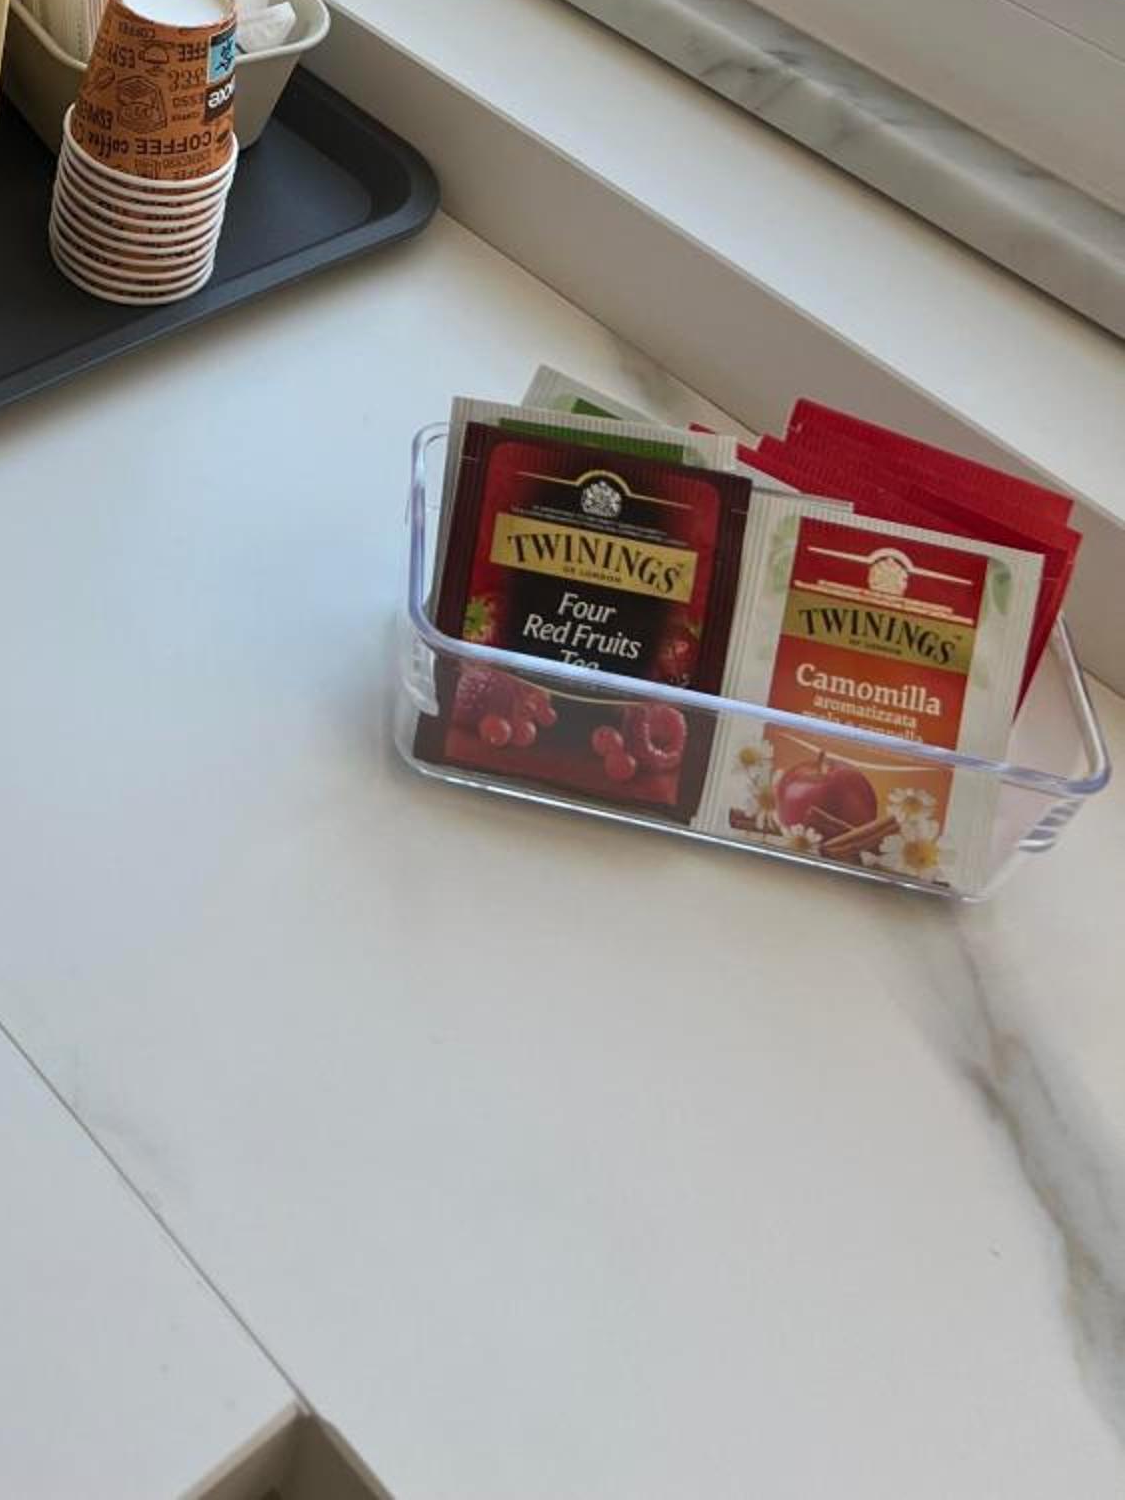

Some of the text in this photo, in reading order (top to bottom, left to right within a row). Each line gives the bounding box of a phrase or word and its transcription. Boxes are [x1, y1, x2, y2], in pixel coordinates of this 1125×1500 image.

[87, 130, 130, 159] coffee
[135, 130, 212, 156] COFFEE
[507, 533, 682, 593] TWININGS
[557, 591, 616, 624] Four
[522, 613, 643, 660] Red Fruits
[799, 607, 956, 665] TWININGS
[796, 663, 941, 716] Camomilla
[813, 694, 917, 729] aromatizzata
